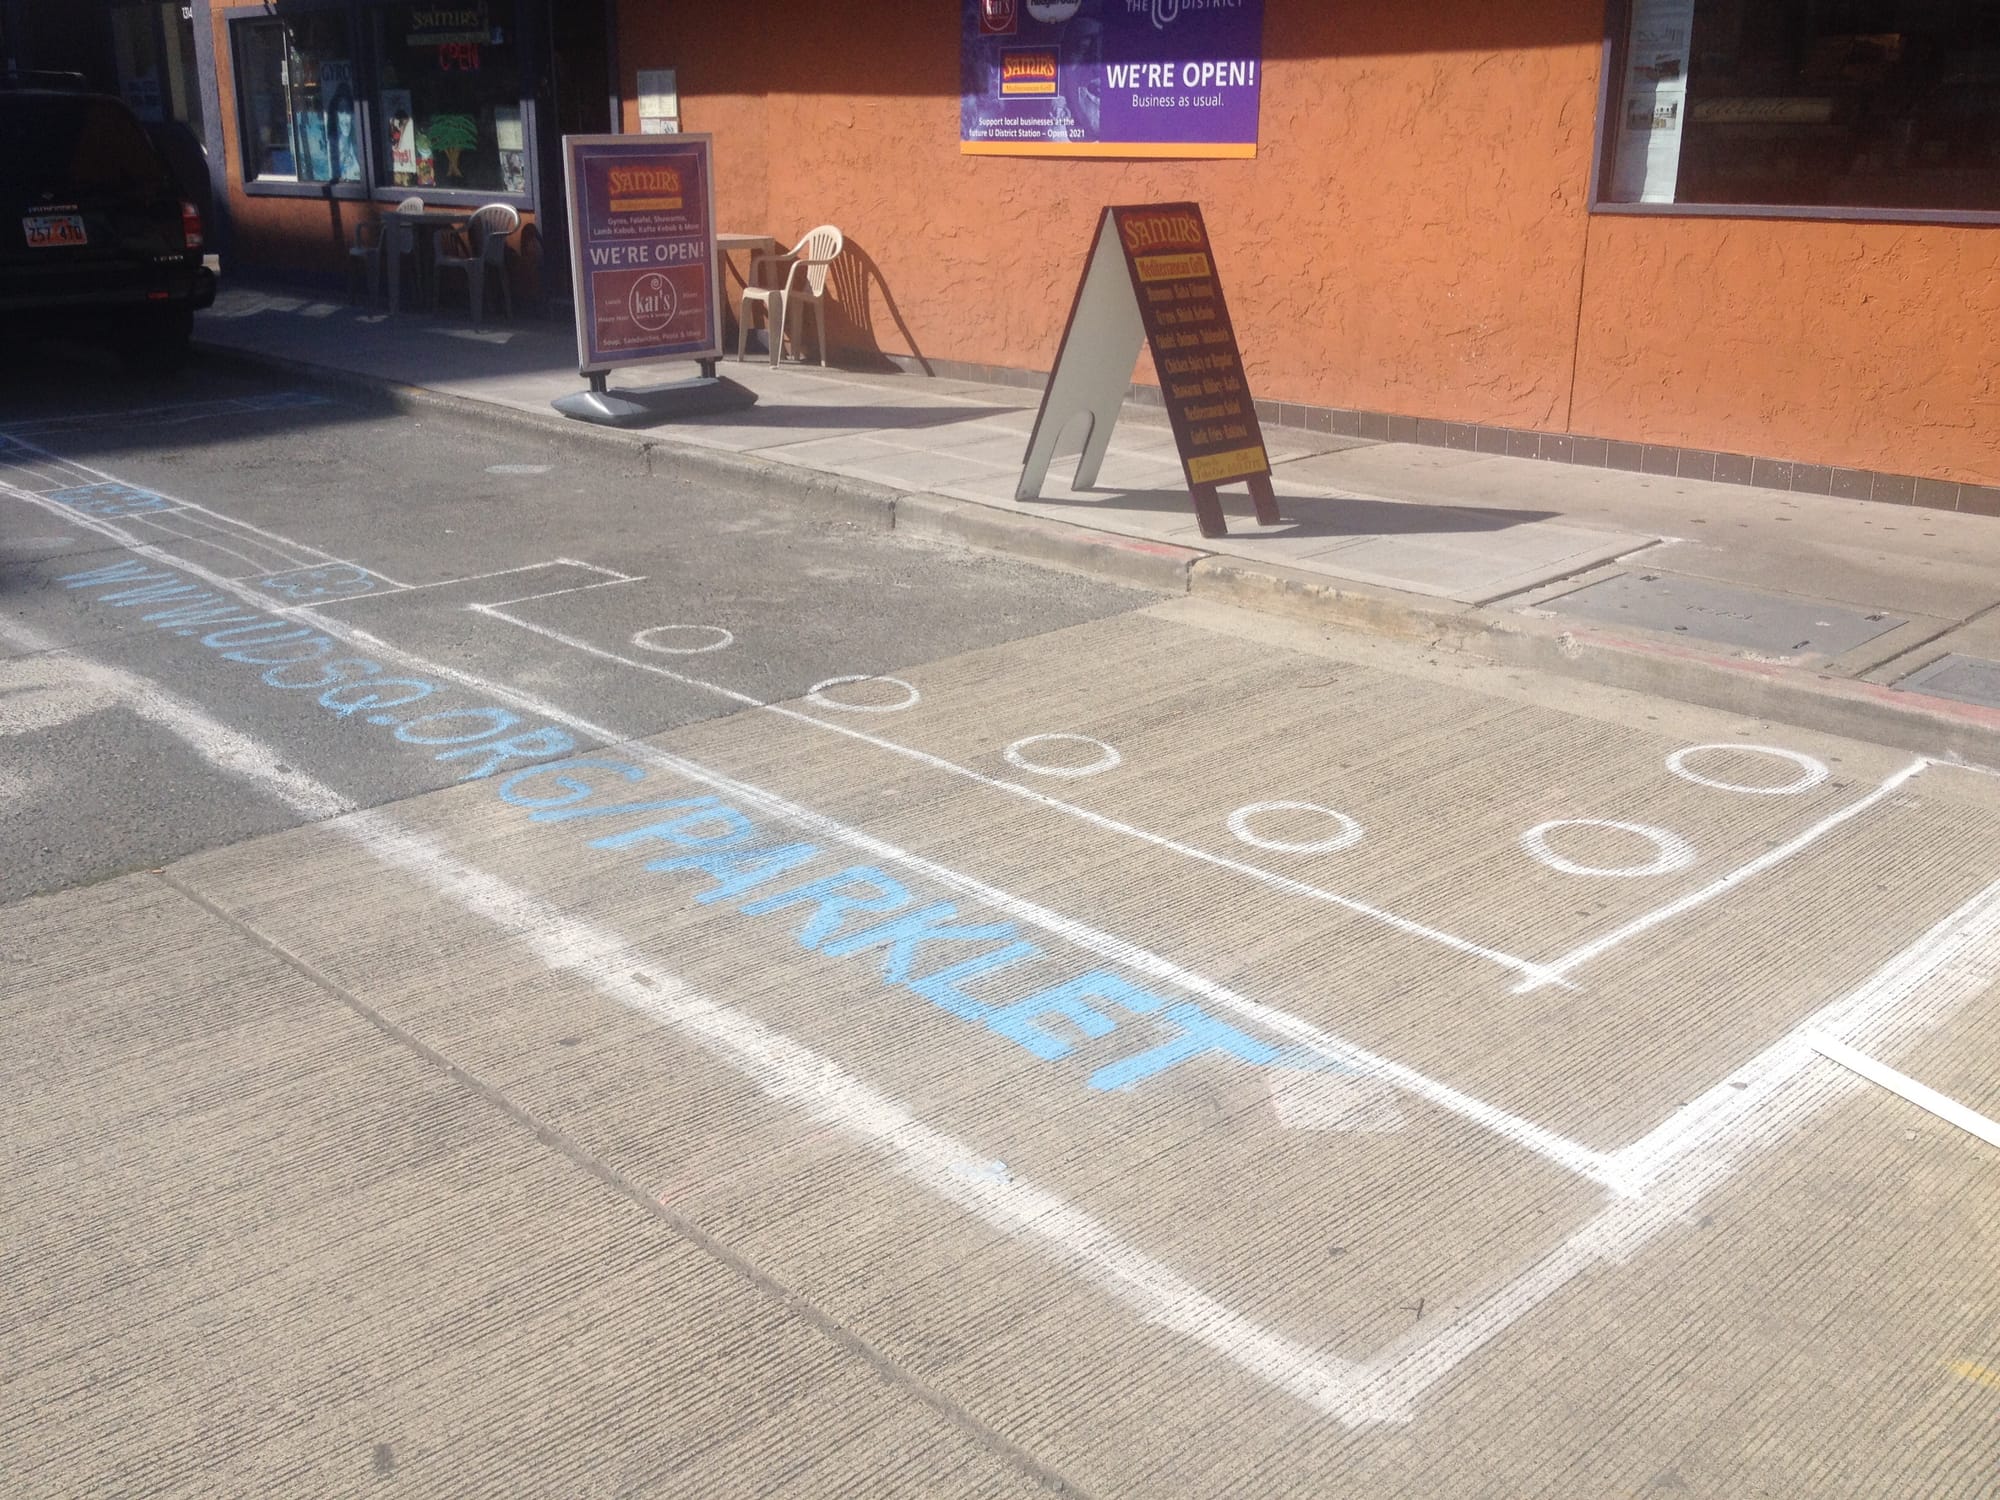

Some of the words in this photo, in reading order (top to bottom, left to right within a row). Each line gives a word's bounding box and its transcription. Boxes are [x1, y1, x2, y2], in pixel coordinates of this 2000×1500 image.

[439, 42, 480, 71] OPEN
[1106, 63, 1175, 89] WE'RE
[1182, 61, 1255, 87] OPEN!
[1132, 94, 1175, 107] Business
[1178, 96, 1190, 107] as
[1193, 93, 1224, 107] usual.
[979, 117, 1003, 127] Support
[1004, 117, 1019, 126] local
[1020, 117, 1054, 126] businesses
[1054, 118, 1062, 126] at
[1063, 117, 1075, 126] the
[988, 129, 994, 137] U
[994, 128, 1018, 137] District
[1018, 128, 1041, 137] Station
[1069, 128, 1085, 137] 2021
[1124, 215, 1201, 249] SAMIR'S
[590, 245, 649, 266] WE'RE
[655, 241, 704, 262] OPEN!
